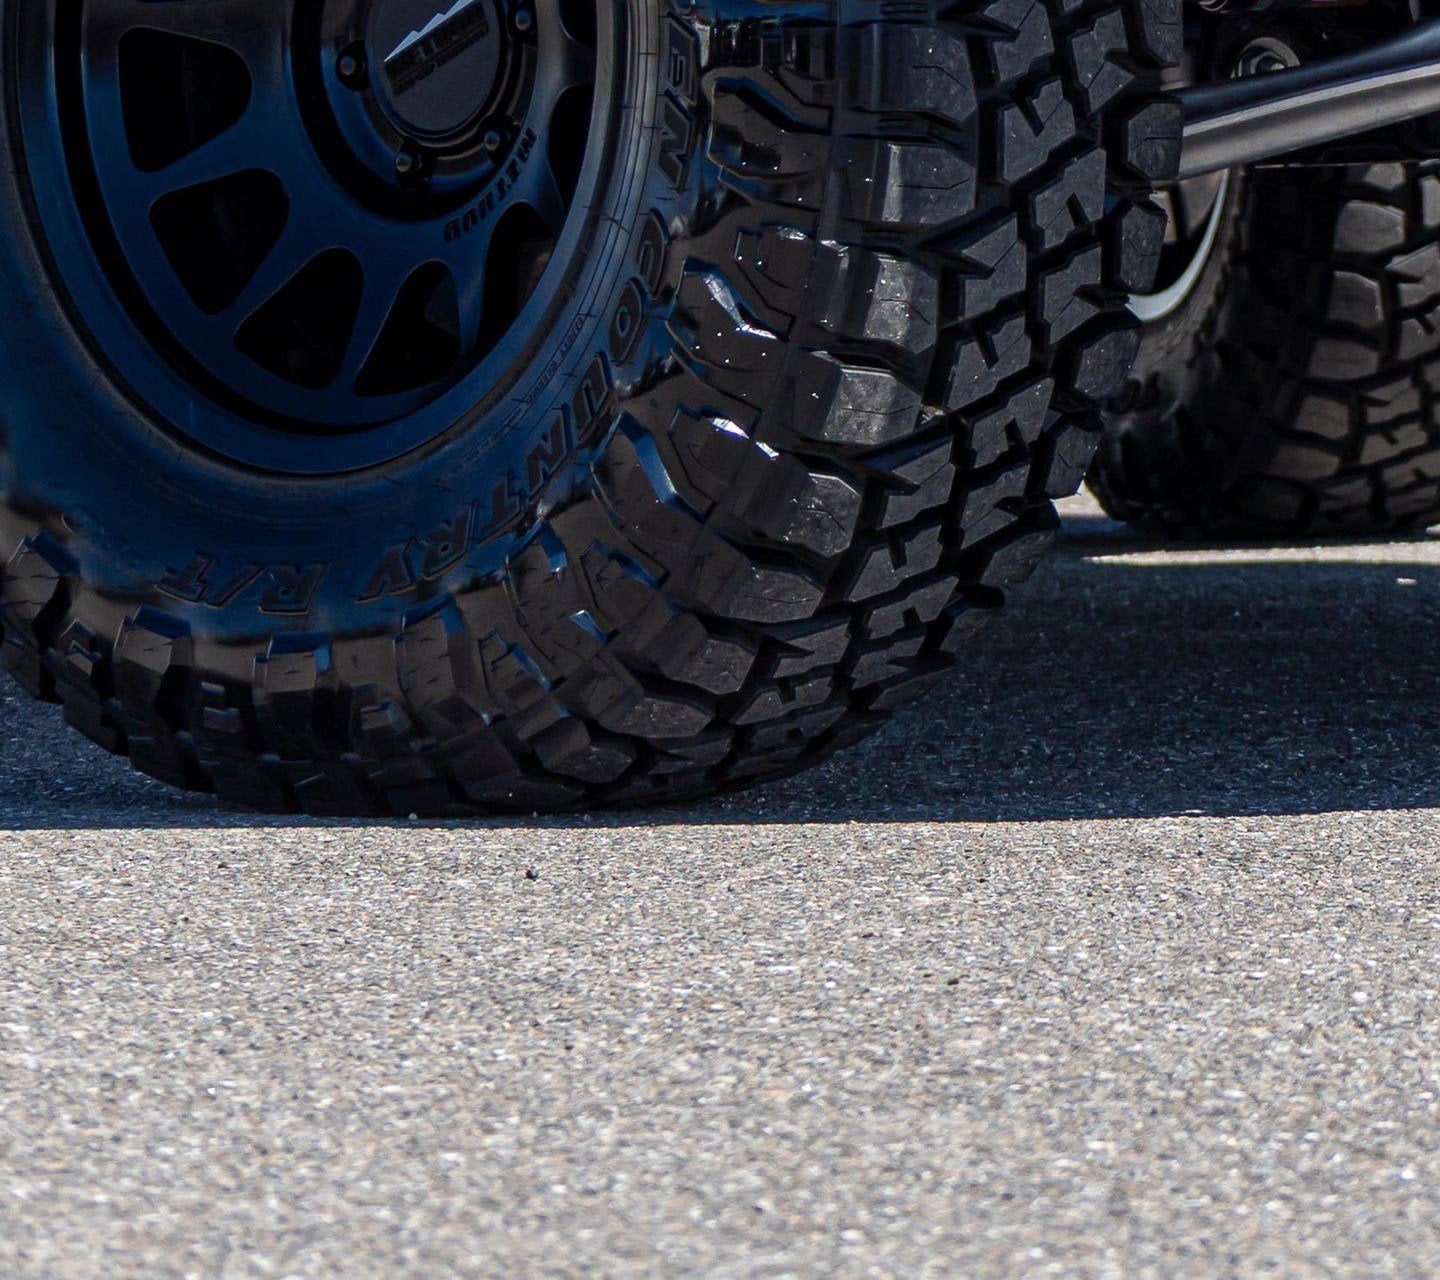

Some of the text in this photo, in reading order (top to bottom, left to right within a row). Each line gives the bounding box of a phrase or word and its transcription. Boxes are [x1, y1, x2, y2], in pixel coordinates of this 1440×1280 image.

[443, 126, 538, 243] METHOD
[355, 205, 677, 605] COUNTRY
[153, 548, 334, 617] R/T
